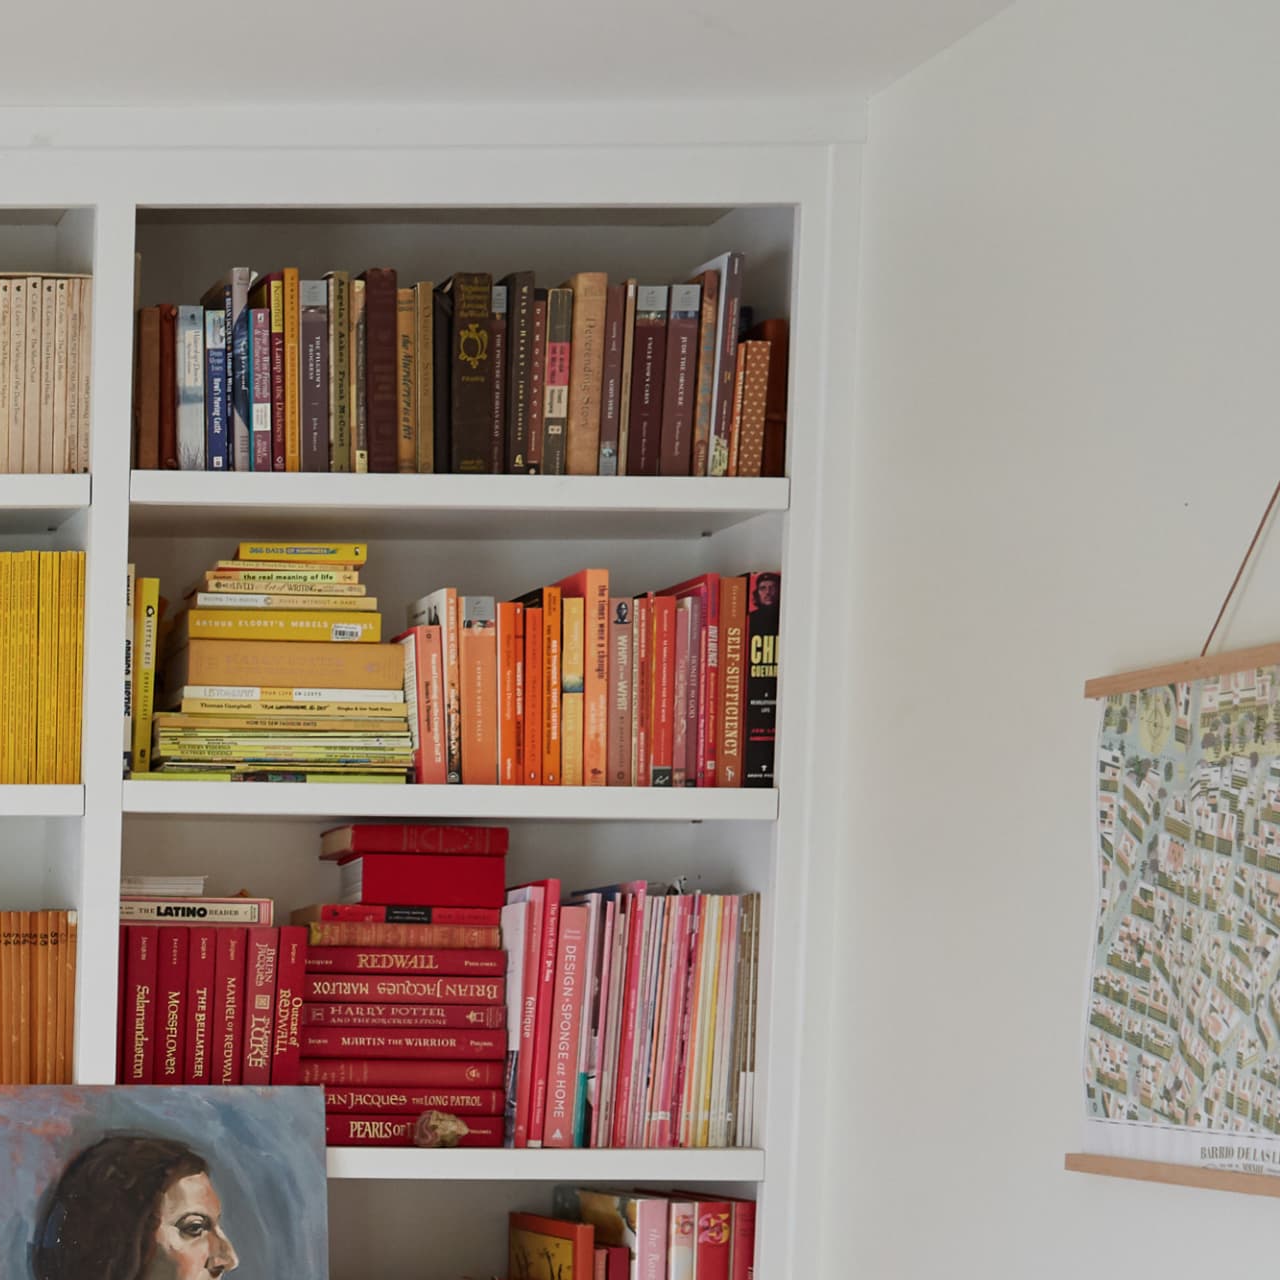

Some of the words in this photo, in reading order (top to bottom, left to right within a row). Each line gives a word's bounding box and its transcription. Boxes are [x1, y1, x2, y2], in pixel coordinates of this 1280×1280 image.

[724, 627, 740, 757] SELF-SUFFICIENCY
[157, 907, 207, 918] LATINO
[357, 954, 438, 969] REDWALL
[197, 987, 207, 1011] THE
[313, 981, 368, 995] MARLFOX
[377, 980, 442, 996] JACQUES
[447, 985, 499, 999] BRIAN
[133, 985, 150, 1078] Salamandastron
[165, 991, 180, 1075] MOSSFLOWER
[274, 989, 290, 1055] REDWALL
[193, 1013, 206, 1078] BELLMAKER
[248, 1016, 267, 1068] LUKE
[557, 1063, 566, 1076] at
[348, 1094, 407, 1111] JACQUES
[424, 1095, 448, 1108] LONG
[450, 1095, 482, 1108] PATROL
[553, 1080, 566, 1118] HOME
